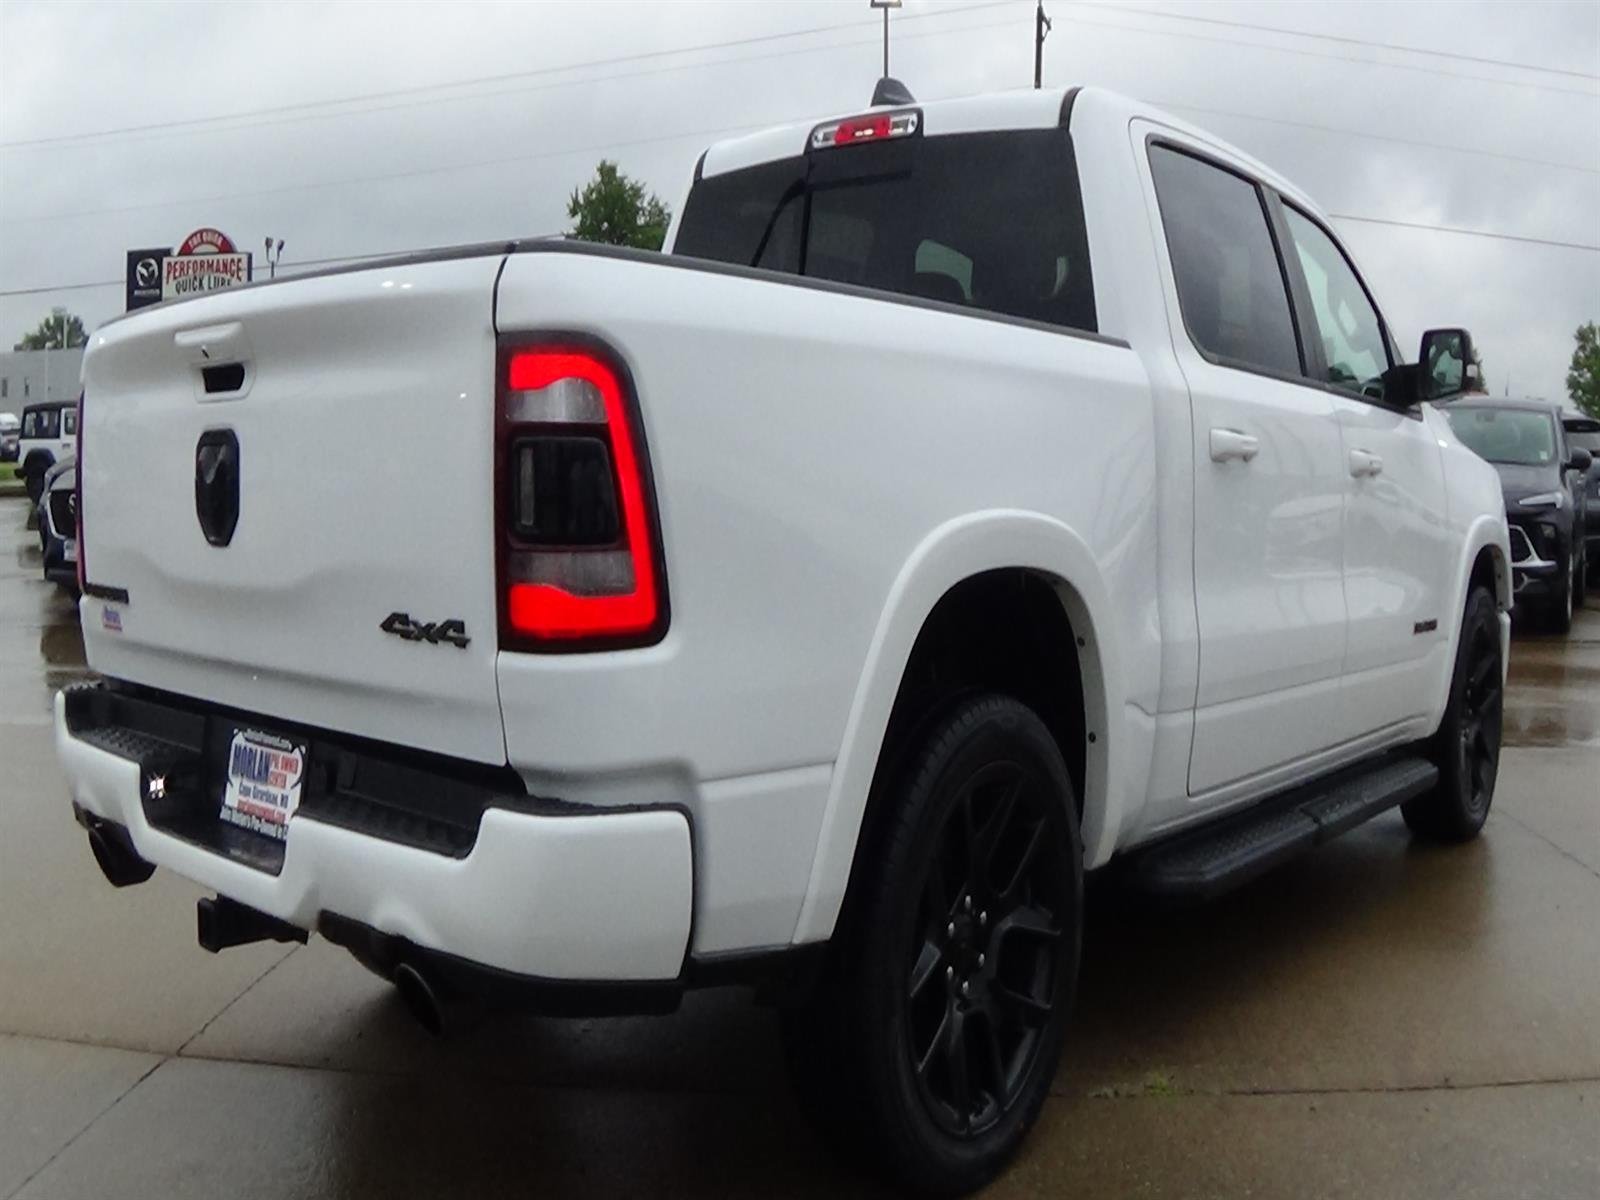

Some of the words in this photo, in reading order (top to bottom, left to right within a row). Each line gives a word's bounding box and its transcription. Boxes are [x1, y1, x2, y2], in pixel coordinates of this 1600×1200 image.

[166, 258, 242, 285] PERFORMANCE
[175, 276, 205, 295] QUICK
[232, 743, 269, 784] MORLAN
